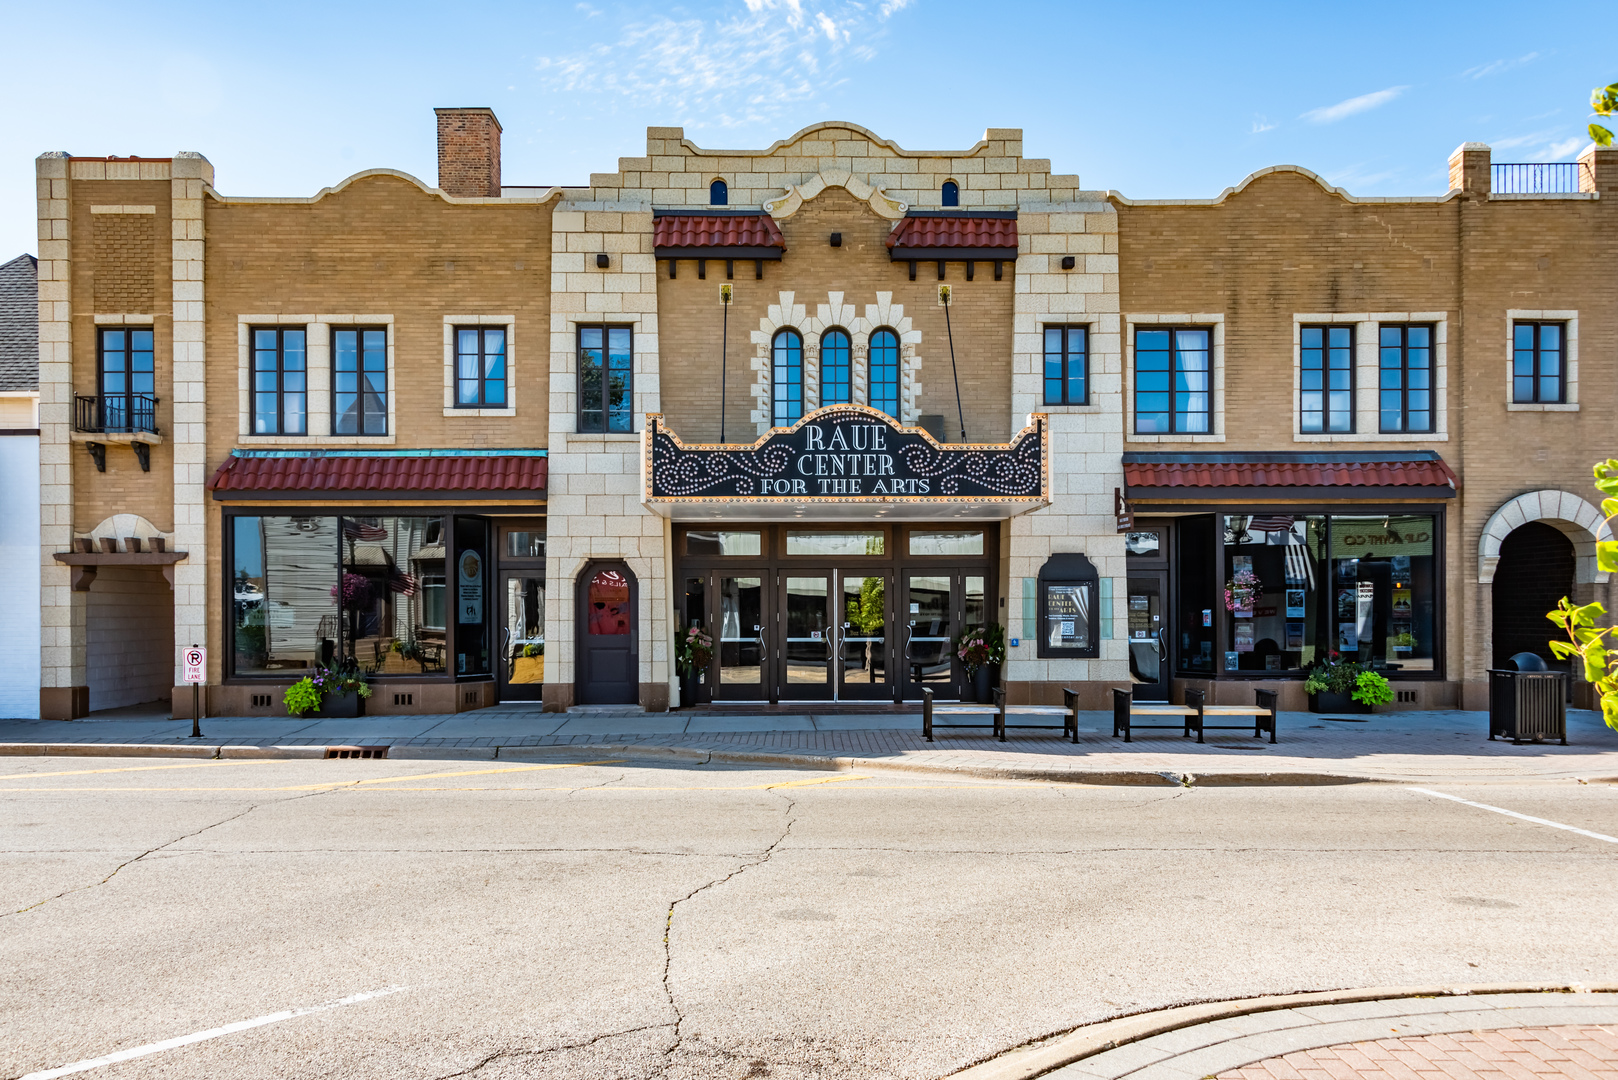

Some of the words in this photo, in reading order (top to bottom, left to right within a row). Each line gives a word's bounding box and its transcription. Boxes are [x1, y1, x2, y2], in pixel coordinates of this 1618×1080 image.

[805, 425, 887, 450] RAUE
[797, 454, 895, 476] CENTER
[760, 479, 808, 494] FOR
[818, 479, 862, 494] THE
[871, 479, 930, 494] ARTS
